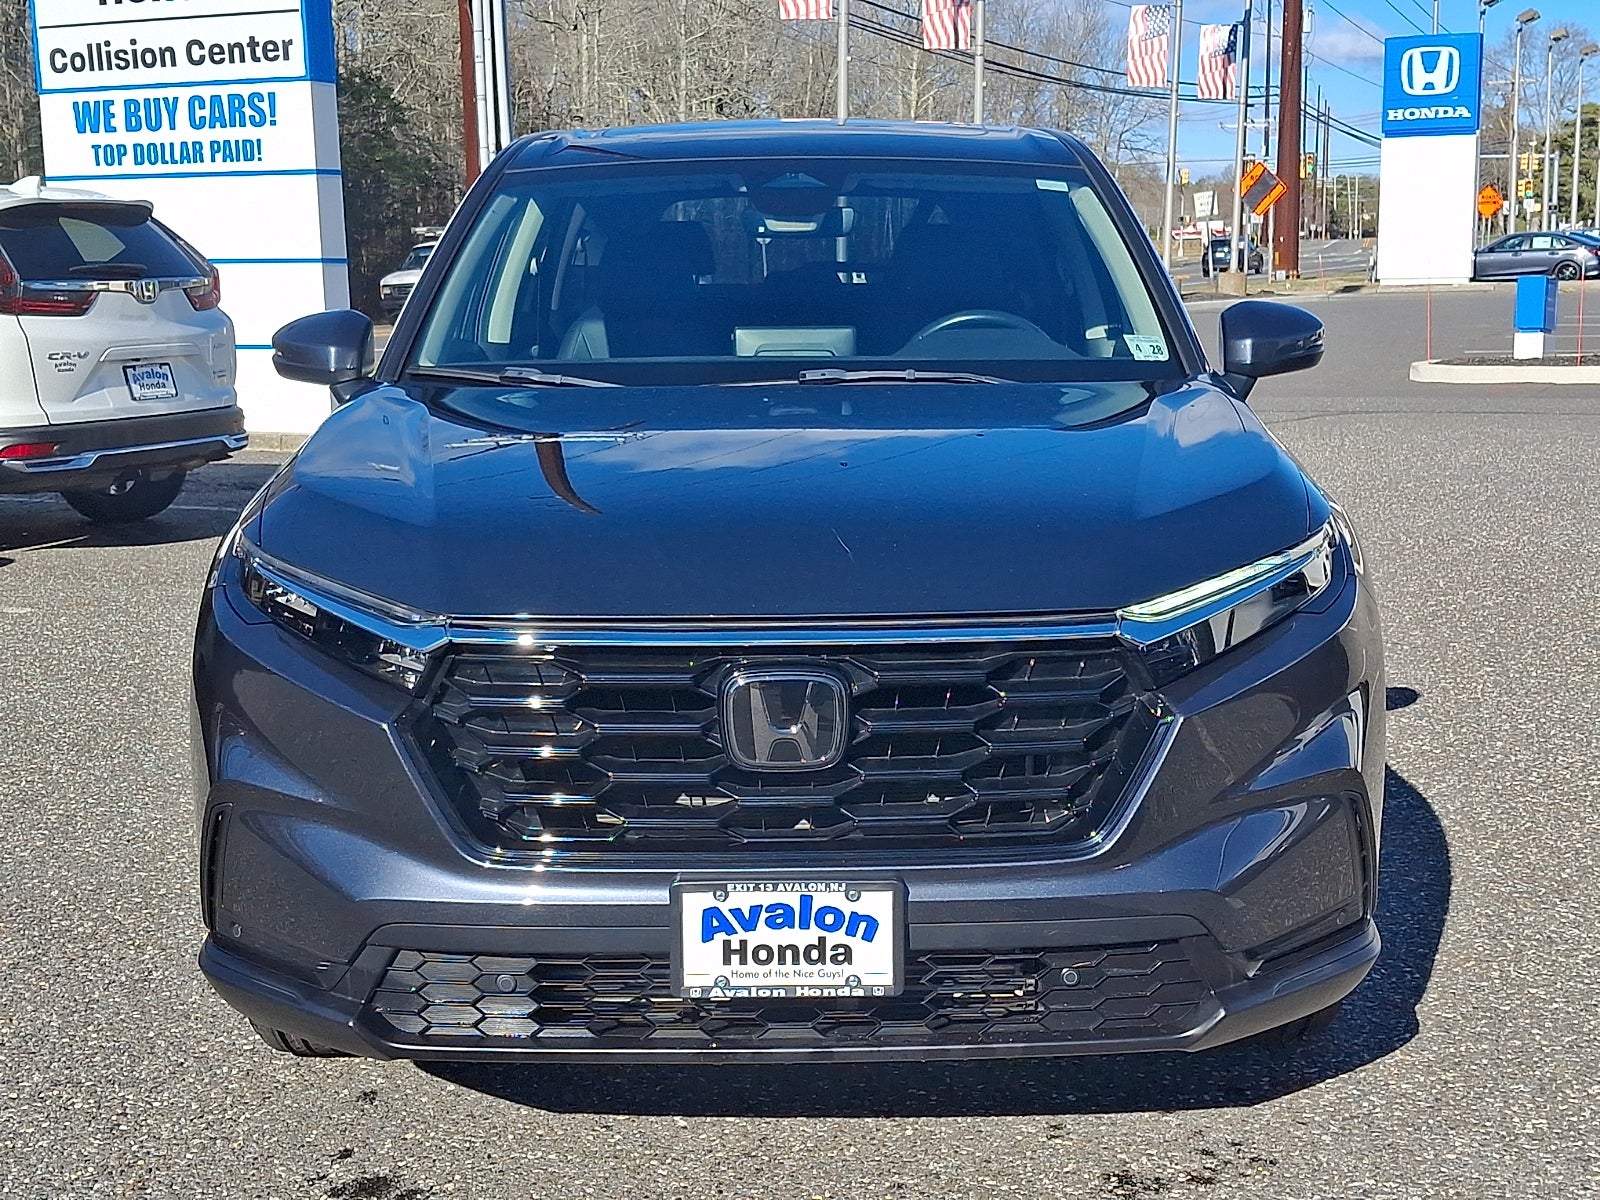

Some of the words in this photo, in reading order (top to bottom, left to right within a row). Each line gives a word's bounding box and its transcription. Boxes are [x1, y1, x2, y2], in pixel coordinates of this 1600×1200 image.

[49, 38, 177, 74] Collision
[185, 35, 293, 67] Center
[72, 100, 117, 134] WE
[124, 97, 179, 132] BUY
[188, 92, 278, 130] CARS!
[1387, 106, 1472, 121] HONDA
[91, 144, 128, 167] TOP
[133, 141, 204, 166] DOLLAR
[210, 138, 263, 162] PAID!
[47, 351, 90, 361] CR-V
[1149, 344, 1164, 356] 28
[54, 360, 78, 369] Avalon
[132, 367, 170, 385] Avalon
[139, 380, 167, 392] Honda
[726, 883, 756, 892] EXIT
[758, 883, 774, 892] 13
[776, 882, 847, 893] AVALON,NJ
[701, 894, 880, 943] Avalon
[722, 936, 853, 966] Honda
[730, 969, 760, 979] Home
[762, 968, 772, 979] of
[774, 968, 790, 979] the
[793, 969, 815, 978] Nice
[817, 968, 844, 980] Guys!
[708, 986, 787, 997] Avalon
[795, 986, 865, 997] Honda
